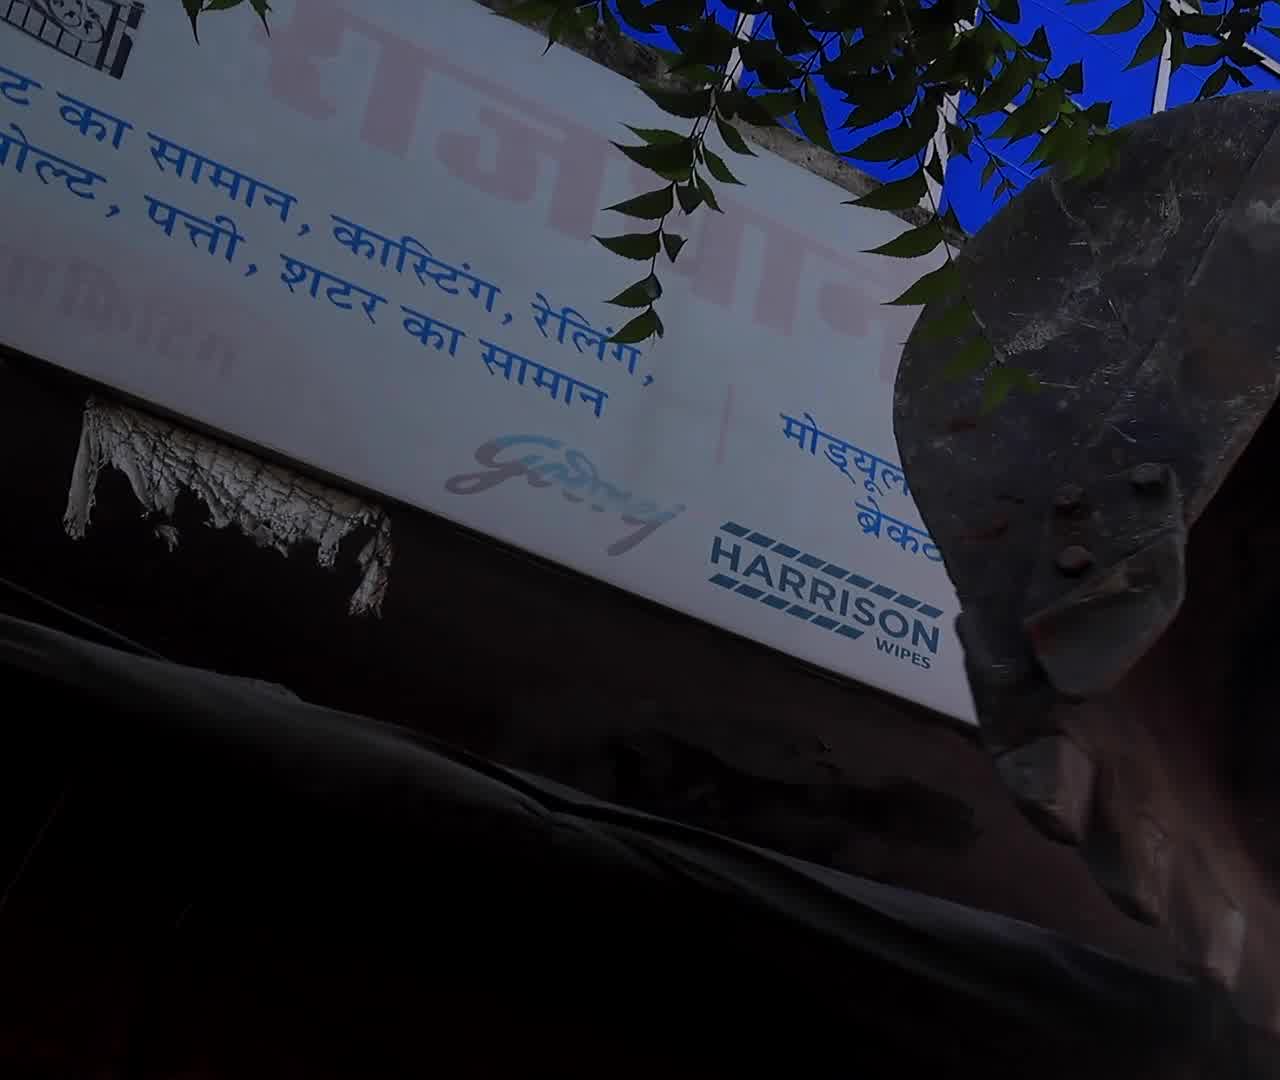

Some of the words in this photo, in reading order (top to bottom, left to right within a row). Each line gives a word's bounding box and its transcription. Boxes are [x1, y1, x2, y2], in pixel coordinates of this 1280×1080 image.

[0, 64, 42, 105] ट
[56, 92, 134, 149] का
[280, 253, 389, 325] शटर
[401, 305, 466, 357] का
[480, 338, 609, 418] सामान
[779, 412, 909, 496] मोड्यूल
[711, 535, 941, 655] HARRISON
[875, 636, 932, 670] WIPES
